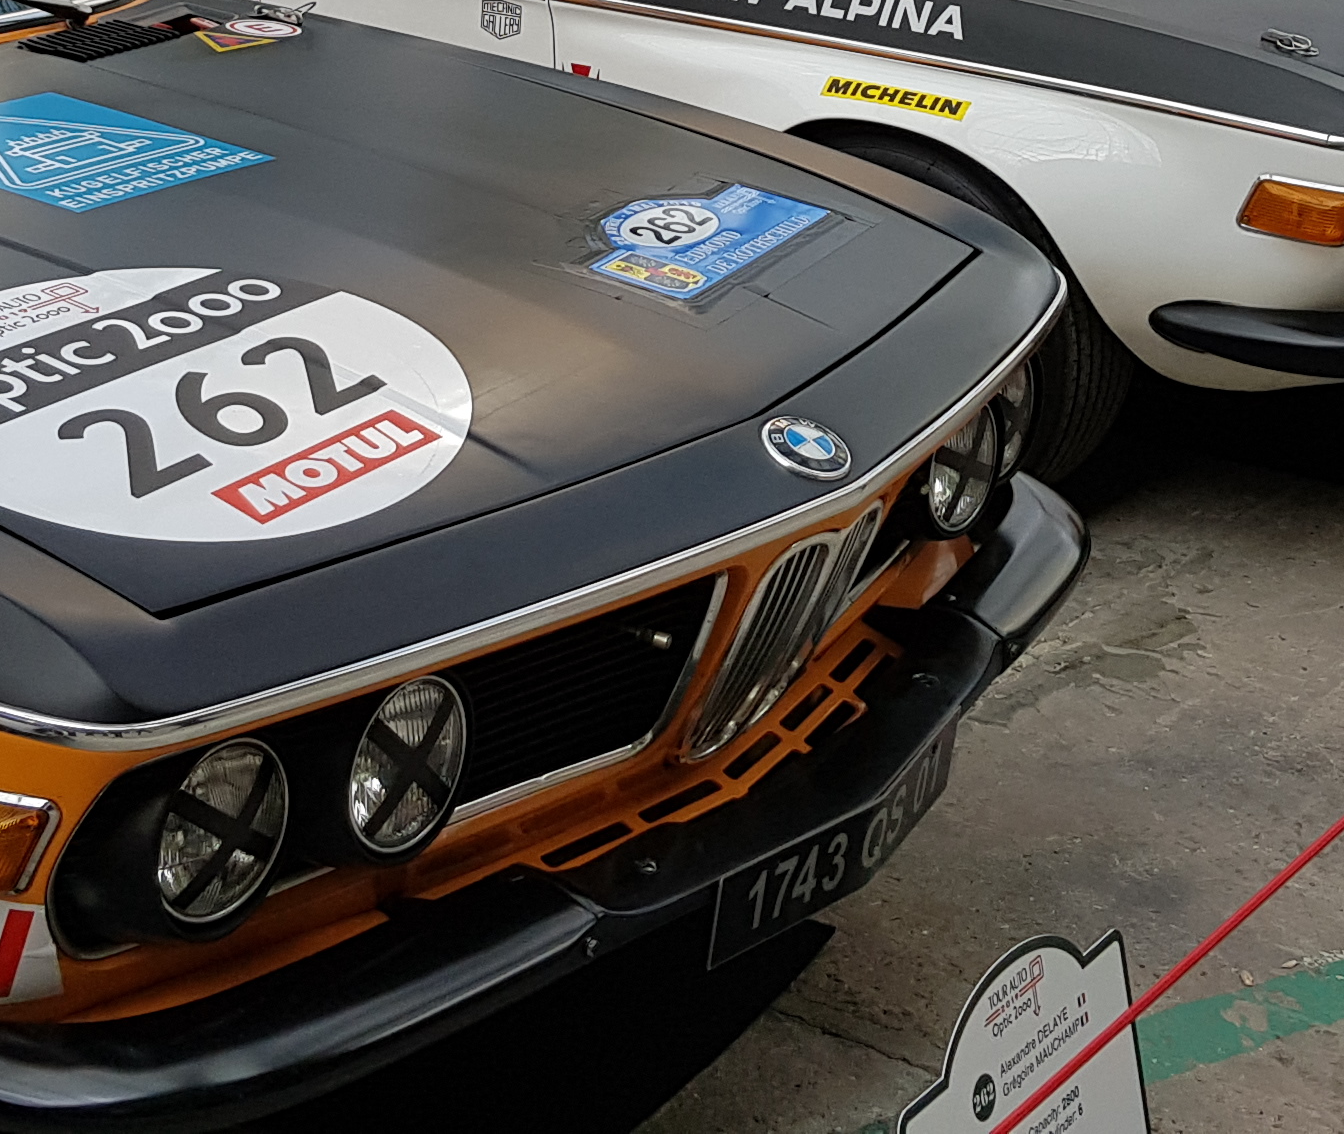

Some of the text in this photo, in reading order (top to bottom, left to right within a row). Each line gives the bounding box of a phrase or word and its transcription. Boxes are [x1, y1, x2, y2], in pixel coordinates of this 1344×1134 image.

[826, 78, 962, 117] MICHELIN
[44, 146, 230, 199] KUGELFISCHER
[58, 150, 263, 210] EINSPRITZPUMPE
[628, 207, 716, 245] 262
[674, 229, 743, 265] EDMOND
[706, 213, 812, 275] DE ROTHSCHILD
[30, 305, 71, 324] 2000
[91, 278, 283, 349] 2000
[56, 336, 389, 499] 262
[235, 419, 426, 518] MOTUL
[747, 832, 849, 930] 1743
[987, 966, 1029, 1011] TOUR AUTO
[991, 1012, 1014, 1039] Optic
[999, 1006, 1070, 1078] Alexandre DELAYE
[1002, 1018, 1082, 1097] Grégoire MAUCHAMP
[972, 1080, 997, 1114] 262
[1077, 1102, 1084, 1116] 6
